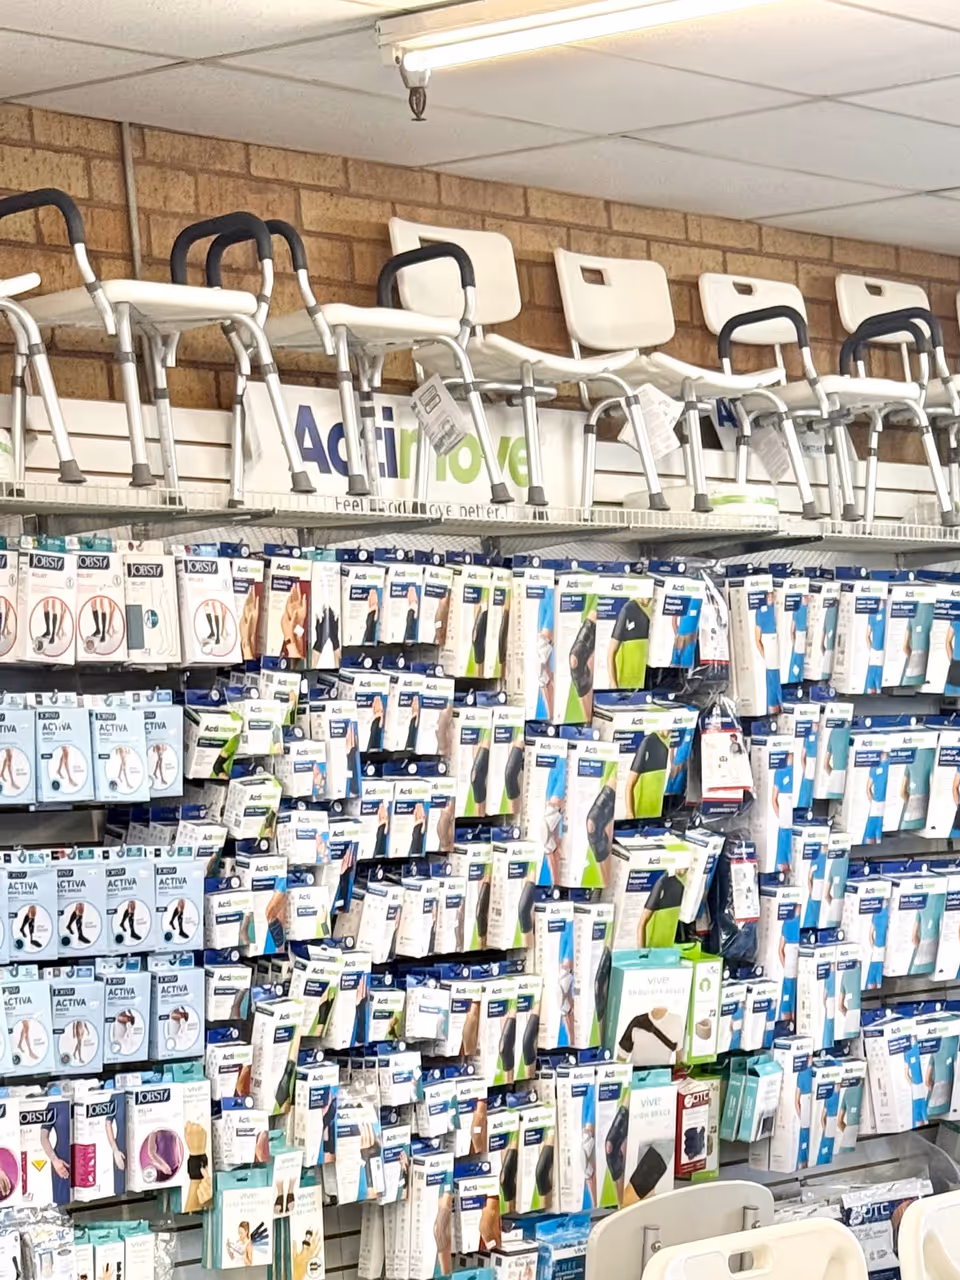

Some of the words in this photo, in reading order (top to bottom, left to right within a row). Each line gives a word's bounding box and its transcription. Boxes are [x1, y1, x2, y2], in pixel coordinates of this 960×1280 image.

[335, 496, 363, 511] Feel
[33, 555, 61, 569] JOBST
[78, 555, 107, 568] JOBST
[186, 560, 215, 573] JOBST
[130, 564, 160, 577] JOBST
[0, 724, 17, 733] TIVA
[99, 724, 128, 732] ACTIVA
[8, 882, 38, 890] ACTIVA
[57, 880, 86, 888] ACTIVA
[107, 878, 137, 887] ACTIVA
[159, 877, 187, 886] ACTIVA
[108, 988, 135, 996] ACTIVA
[161, 985, 188, 994] ACTIVA
[56, 999, 86, 1007] ACTIVA
[136, 1090, 170, 1104] JOBST
[88, 1102, 115, 1117] JOBST
[20, 1112, 53, 1123] OBST
[864, 1203, 889, 1217] OTC
